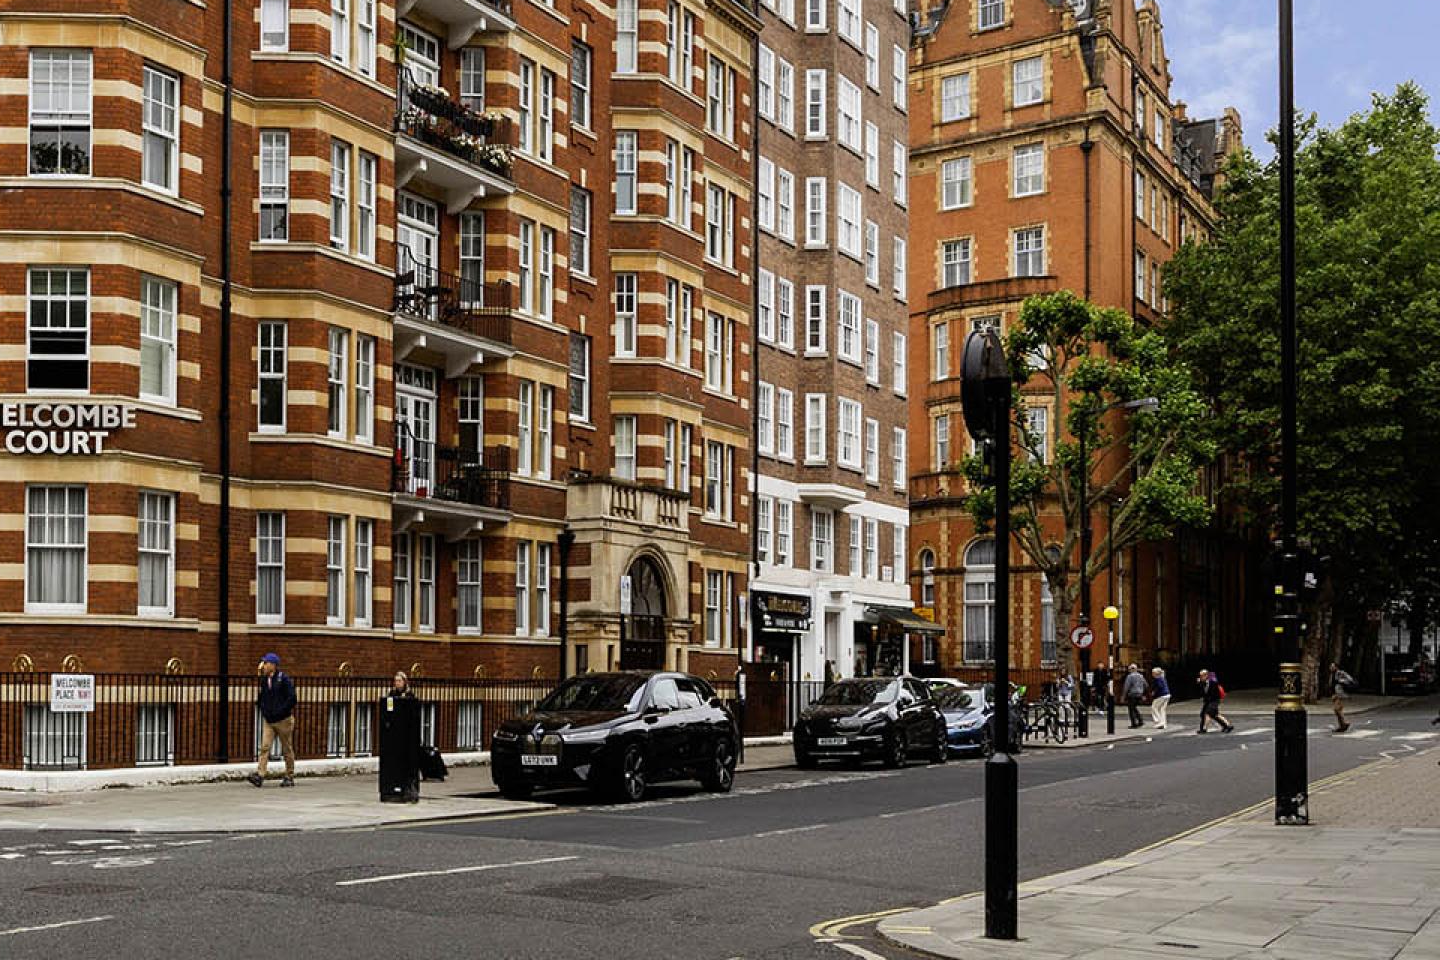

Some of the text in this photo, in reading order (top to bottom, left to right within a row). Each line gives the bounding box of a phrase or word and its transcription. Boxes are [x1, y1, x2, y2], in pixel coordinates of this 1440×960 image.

[5, 430, 109, 454] COURT
[55, 678, 91, 688] MELCOMBE
[55, 689, 74, 700] PLACE
